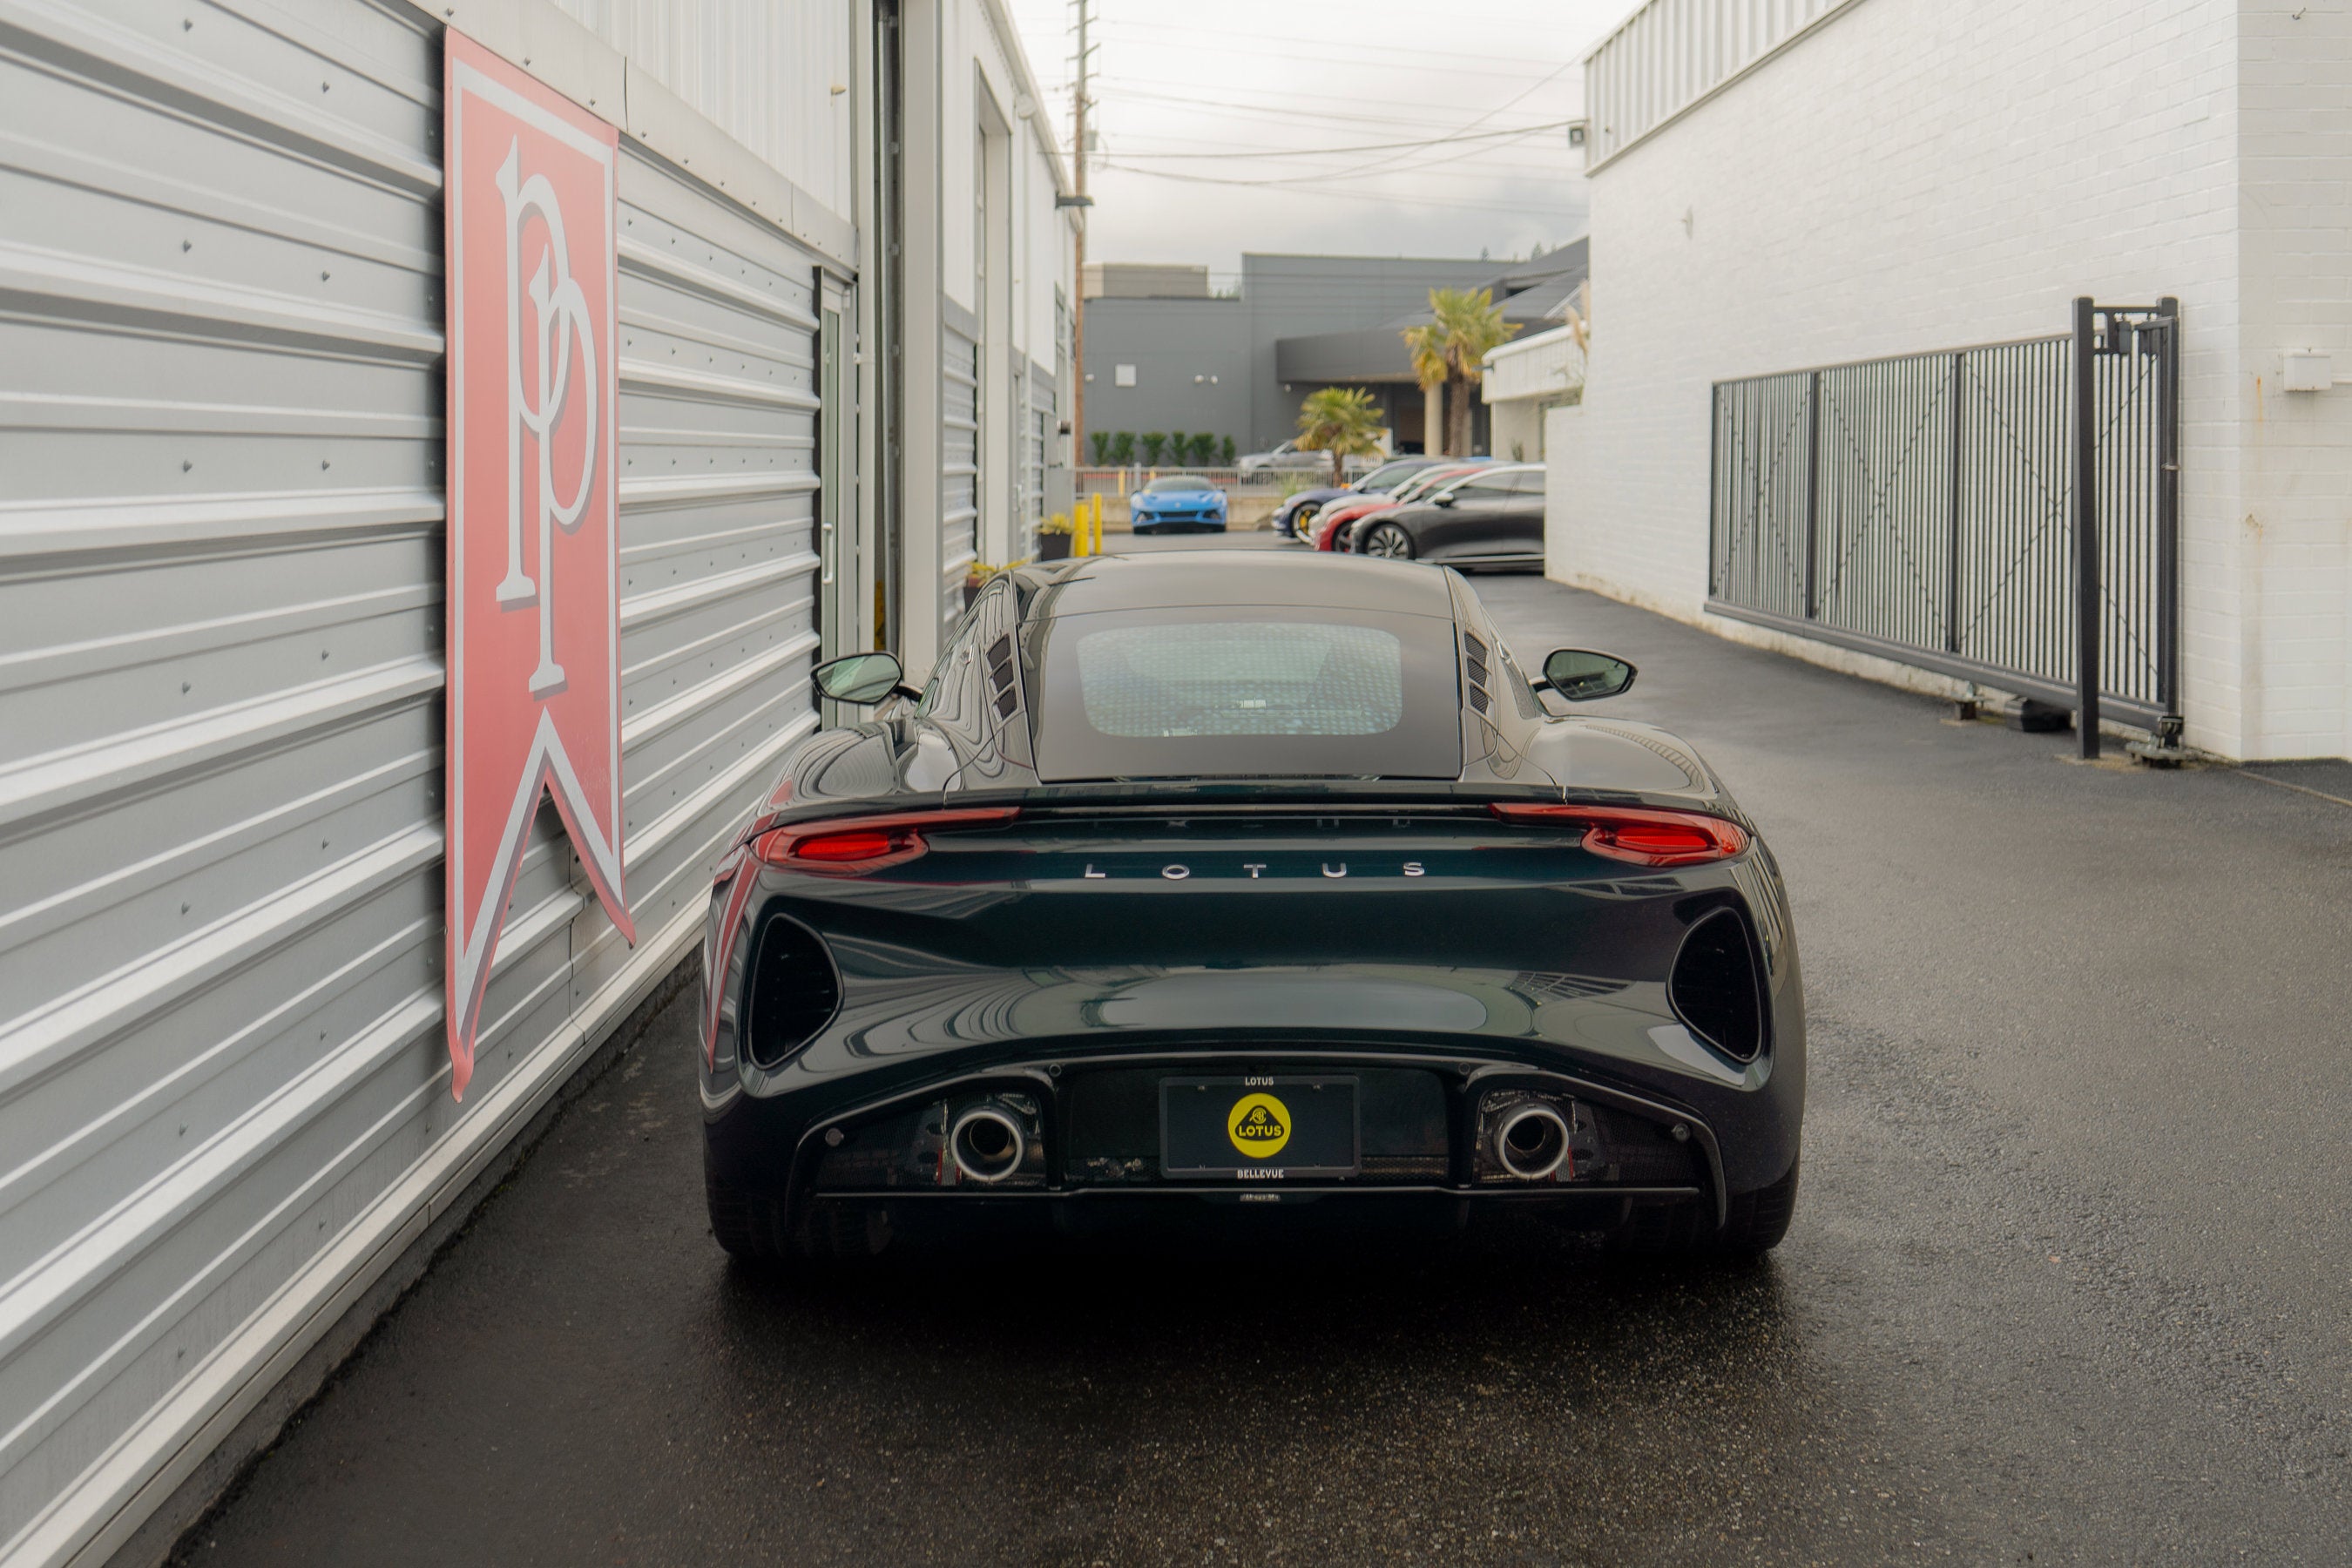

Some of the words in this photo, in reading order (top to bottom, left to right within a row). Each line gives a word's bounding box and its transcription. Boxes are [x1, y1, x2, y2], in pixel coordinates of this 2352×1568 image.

[1085, 862, 1425, 880] LOTUS
[1245, 1076, 1274, 1086] LOTUS
[1238, 1125, 1282, 1137] LOTUS
[1237, 1168, 1284, 1179] BELLEVUE
